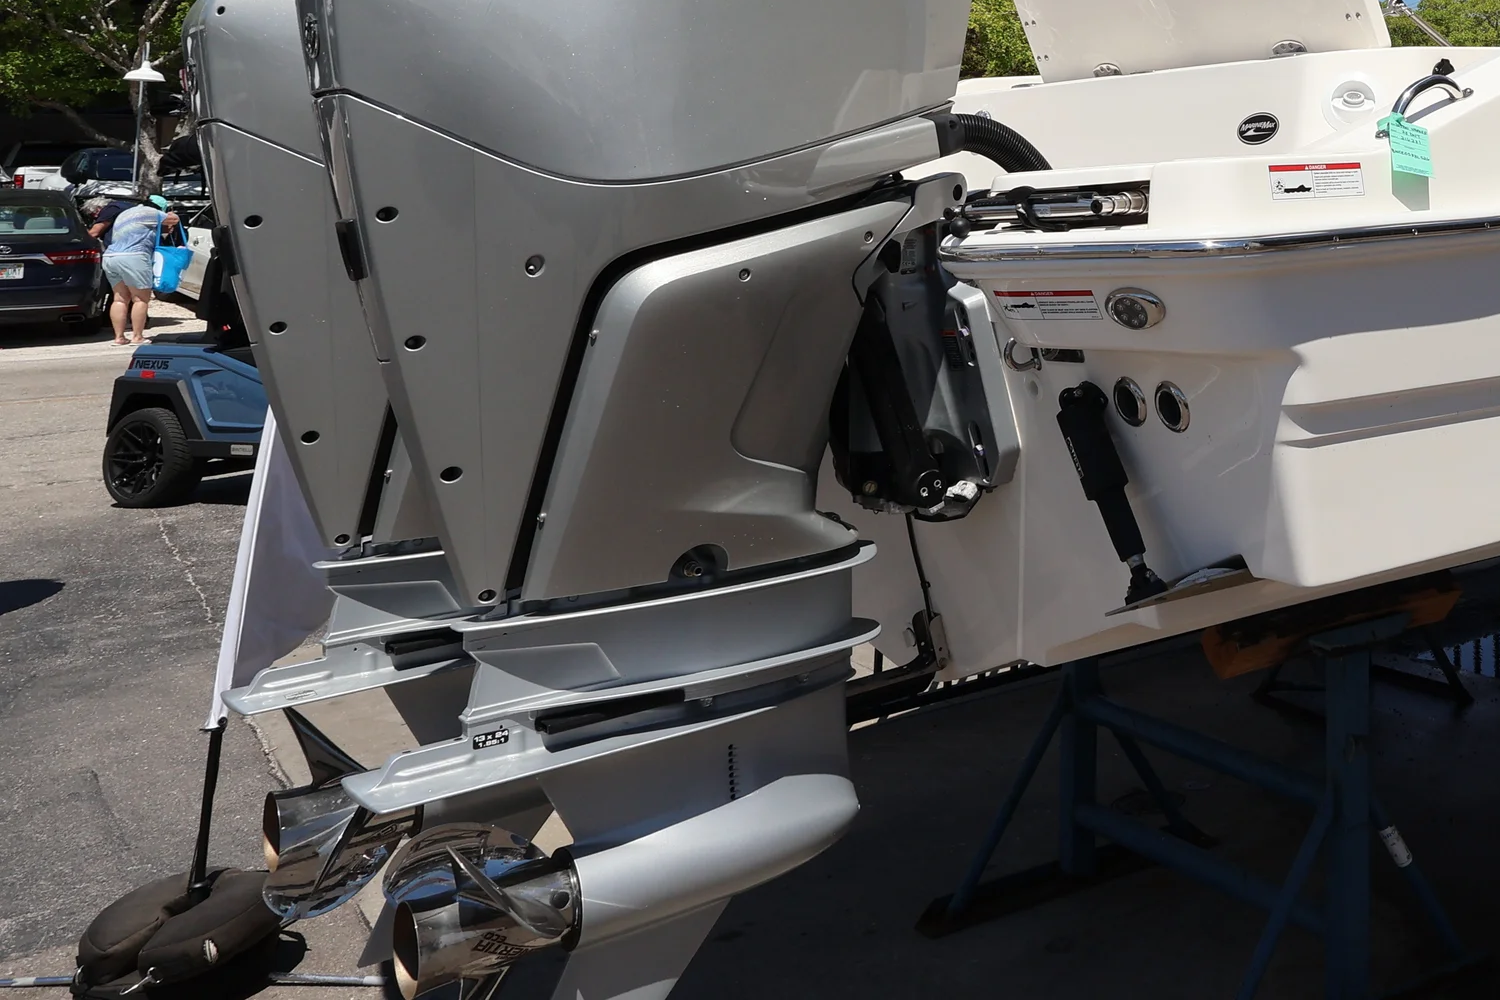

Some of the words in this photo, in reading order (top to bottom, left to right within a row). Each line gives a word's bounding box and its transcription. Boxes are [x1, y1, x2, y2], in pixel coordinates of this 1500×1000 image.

[135, 360, 169, 370] NEXUS
[494, 730, 508, 738] 24
[484, 932, 508, 943] ECO
